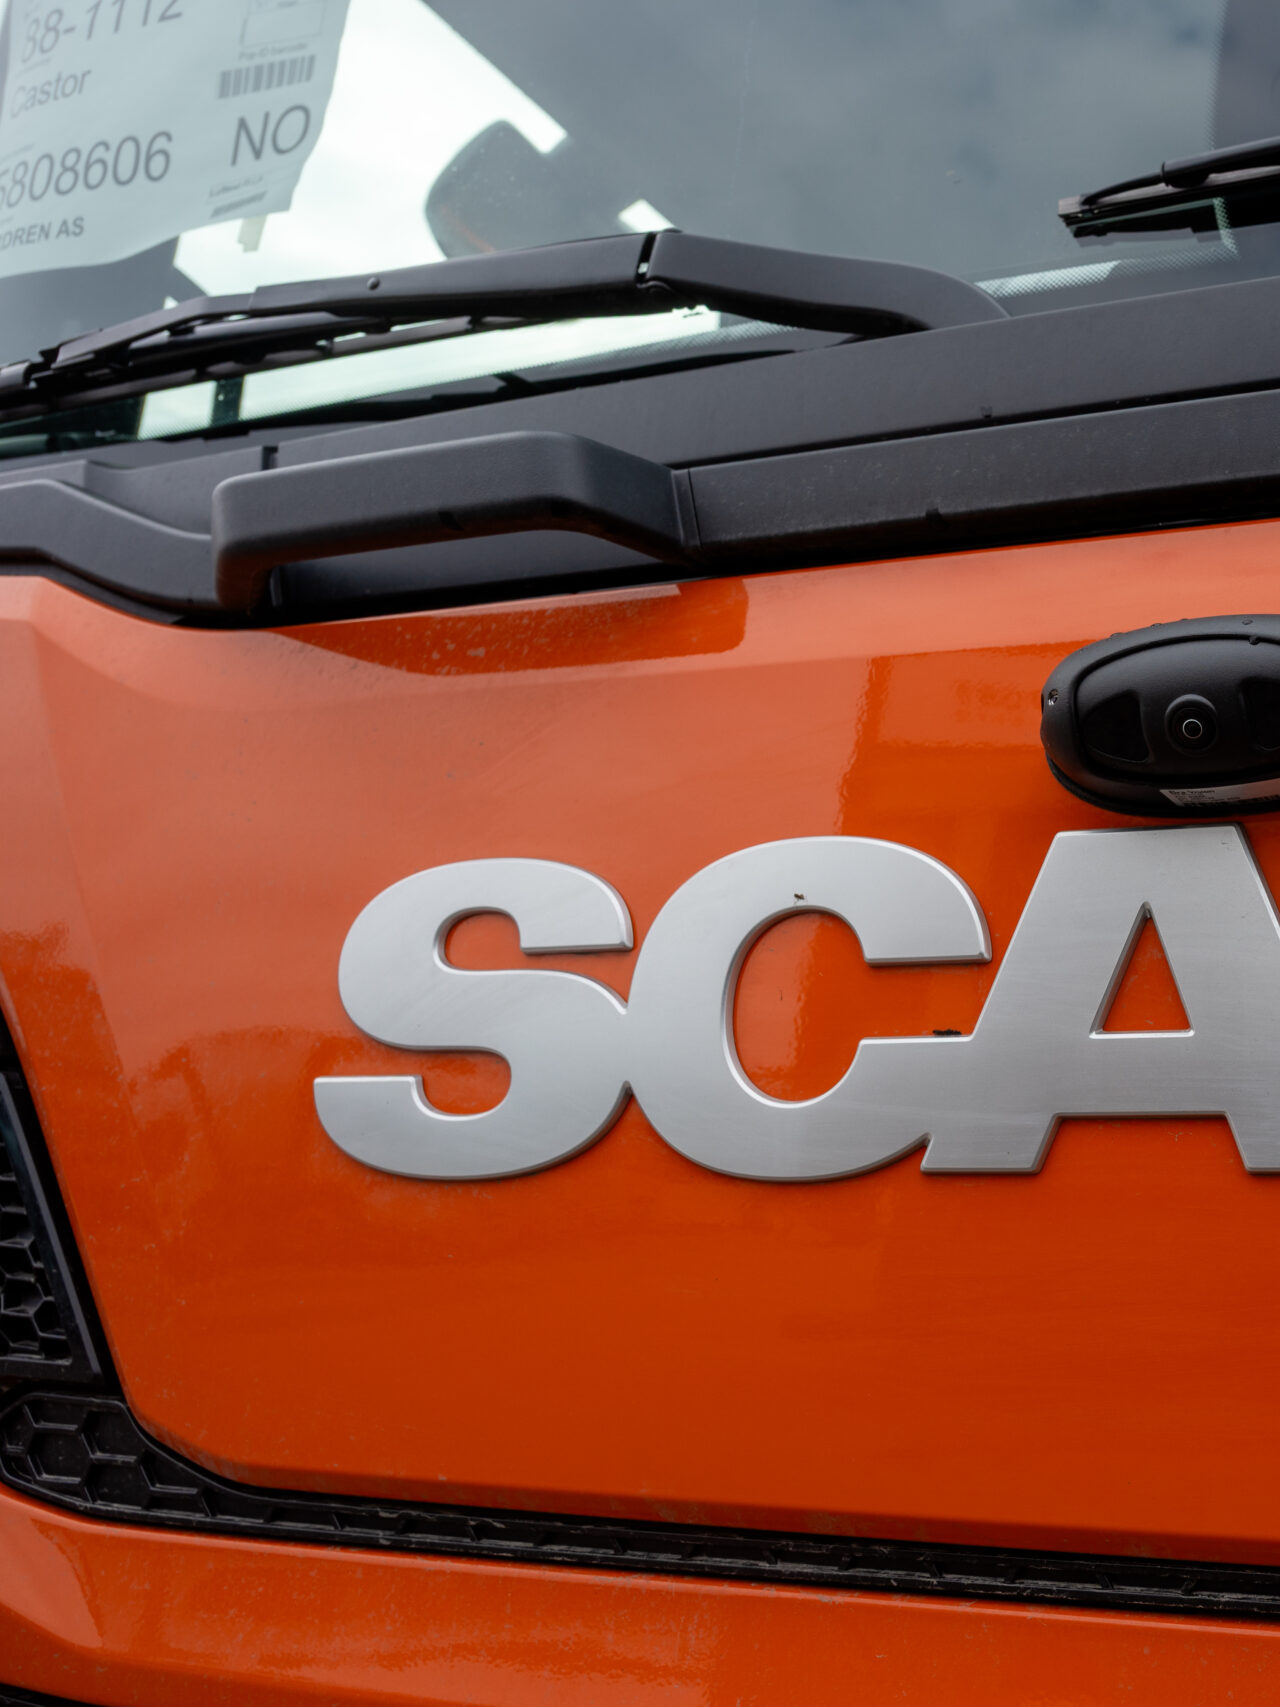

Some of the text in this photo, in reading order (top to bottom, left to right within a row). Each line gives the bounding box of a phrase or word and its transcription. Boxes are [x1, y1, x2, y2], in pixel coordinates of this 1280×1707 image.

[10, 69, 92, 119] Castor
[230, 104, 311, 167] NO
[56, 216, 85, 240] AS
